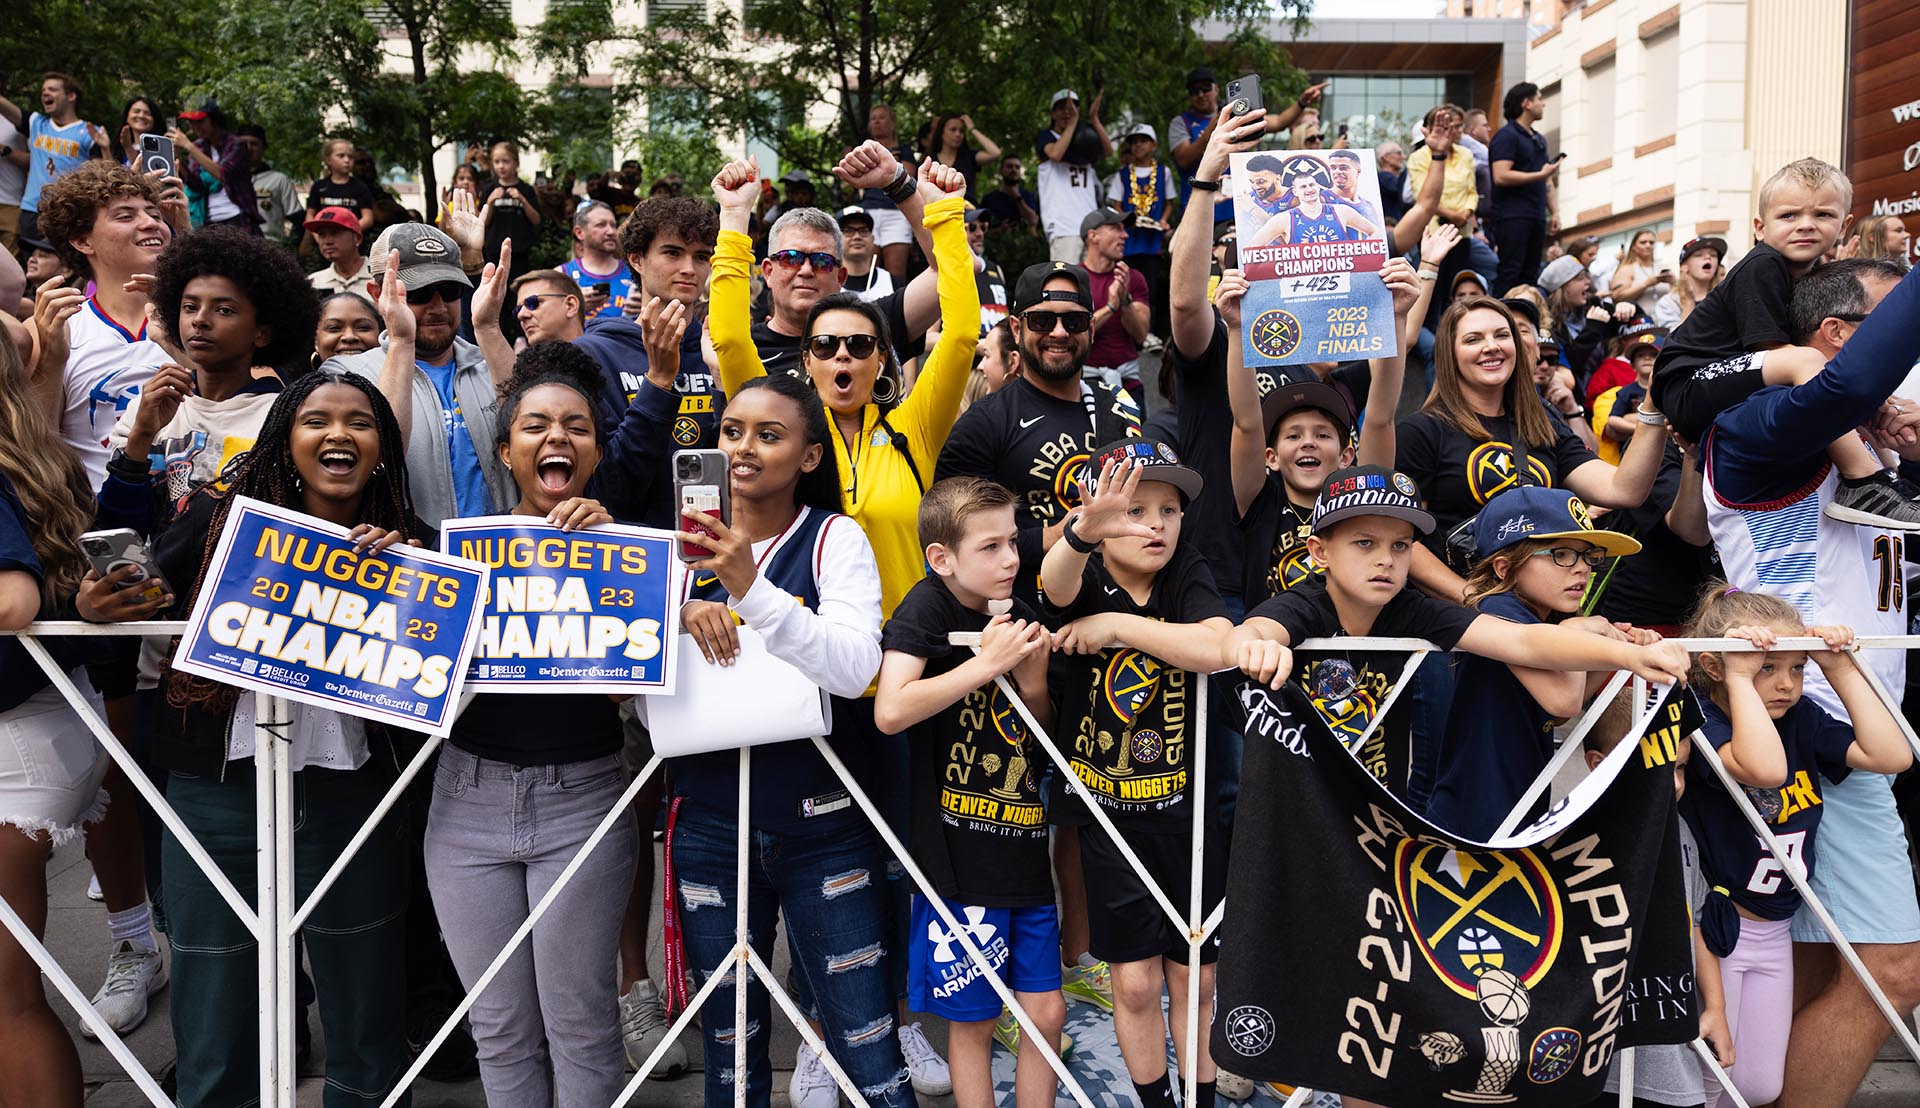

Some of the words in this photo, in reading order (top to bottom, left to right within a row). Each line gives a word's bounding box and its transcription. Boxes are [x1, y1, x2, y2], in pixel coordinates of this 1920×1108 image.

[1068, 166, 1088, 188] 27
[1318, 224, 1339, 241] HIGH
[1241, 246, 1300, 264] WESTERN
[1303, 241, 1388, 259] CONFERENCE
[1275, 257, 1354, 276] CHAMPIONS
[1290, 275, 1341, 292] +425
[1327, 306, 1368, 322] 2023
[1328, 323, 1369, 337] NBA
[1317, 336, 1383, 355] FINALS
[1029, 432, 1078, 481] NBA
[1135, 443, 1155, 457] NBA
[1329, 477, 1356, 497] 22-23
[1366, 475, 1386, 489] NBA
[1521, 523, 1535, 533] 15
[255, 527, 461, 608] NUGGETS
[460, 537, 648, 574] NUGGETS
[1872, 534, 1903, 613] 15
[251, 576, 290, 602] 20
[496, 576, 593, 612] NBA
[599, 587, 635, 607] 23
[291, 580, 398, 641] NBA
[405, 618, 439, 642] 23
[472, 615, 662, 661] HAMPS
[208, 601, 453, 698] CHAMPS
[271, 666, 310, 683] BELLCO
[498, 665, 526, 675] BELLCO
[539, 667, 551, 675] The
[551, 666, 589, 678] Denver
[588, 665, 629, 678] Gazette
[325, 682, 338, 691] The
[337, 685, 376, 702] Denver
[375, 694, 414, 711] Gazette
[1163, 669, 1185, 766] PIONS
[1069, 760, 1115, 795] DENVER
[1119, 770, 1187, 799] NUGGETS
[941, 788, 999, 819] DENVER
[1001, 804, 1045, 825] NUGGE
[969, 821, 997, 834] BRING
[1000, 827, 1010, 836] IT
[1013, 828, 1023, 837] IN
[941, 936, 1006, 981] UNER
[1337, 887, 1412, 1079] 22-23
[1541, 832, 1633, 1078] MPIONS
[933, 947, 1010, 999] ARMOUR
[1625, 972, 1692, 1001] RING
[1657, 998, 1688, 1020] IN
